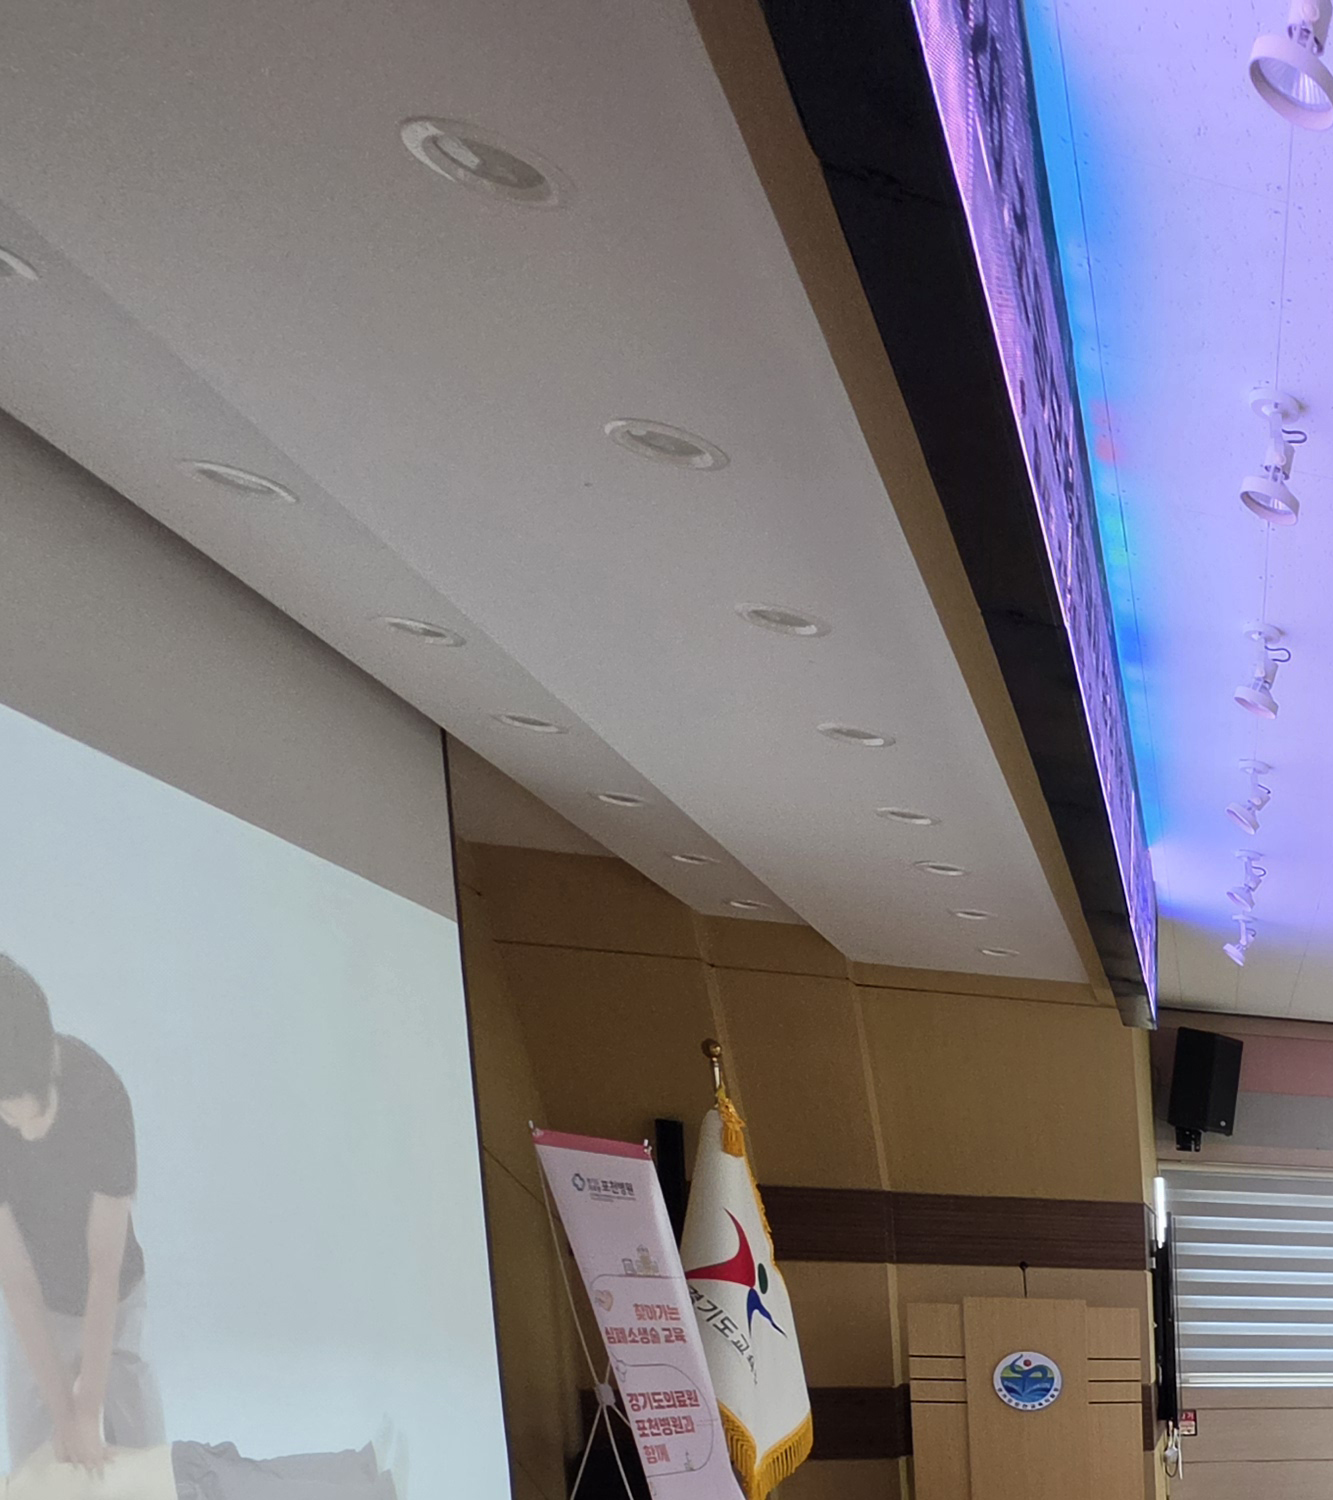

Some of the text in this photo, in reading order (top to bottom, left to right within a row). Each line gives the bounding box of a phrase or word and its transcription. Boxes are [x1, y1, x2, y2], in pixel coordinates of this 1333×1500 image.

[633, 1303, 681, 1321] 찾아가는
[604, 1326, 687, 1345] 심폐소생술 교육
[688, 1285, 758, 1386] 경기도교
[626, 1389, 701, 1412] 경기도의료원
[635, 1415, 696, 1438] 포천병원과
[643, 1443, 671, 1465] 함께
